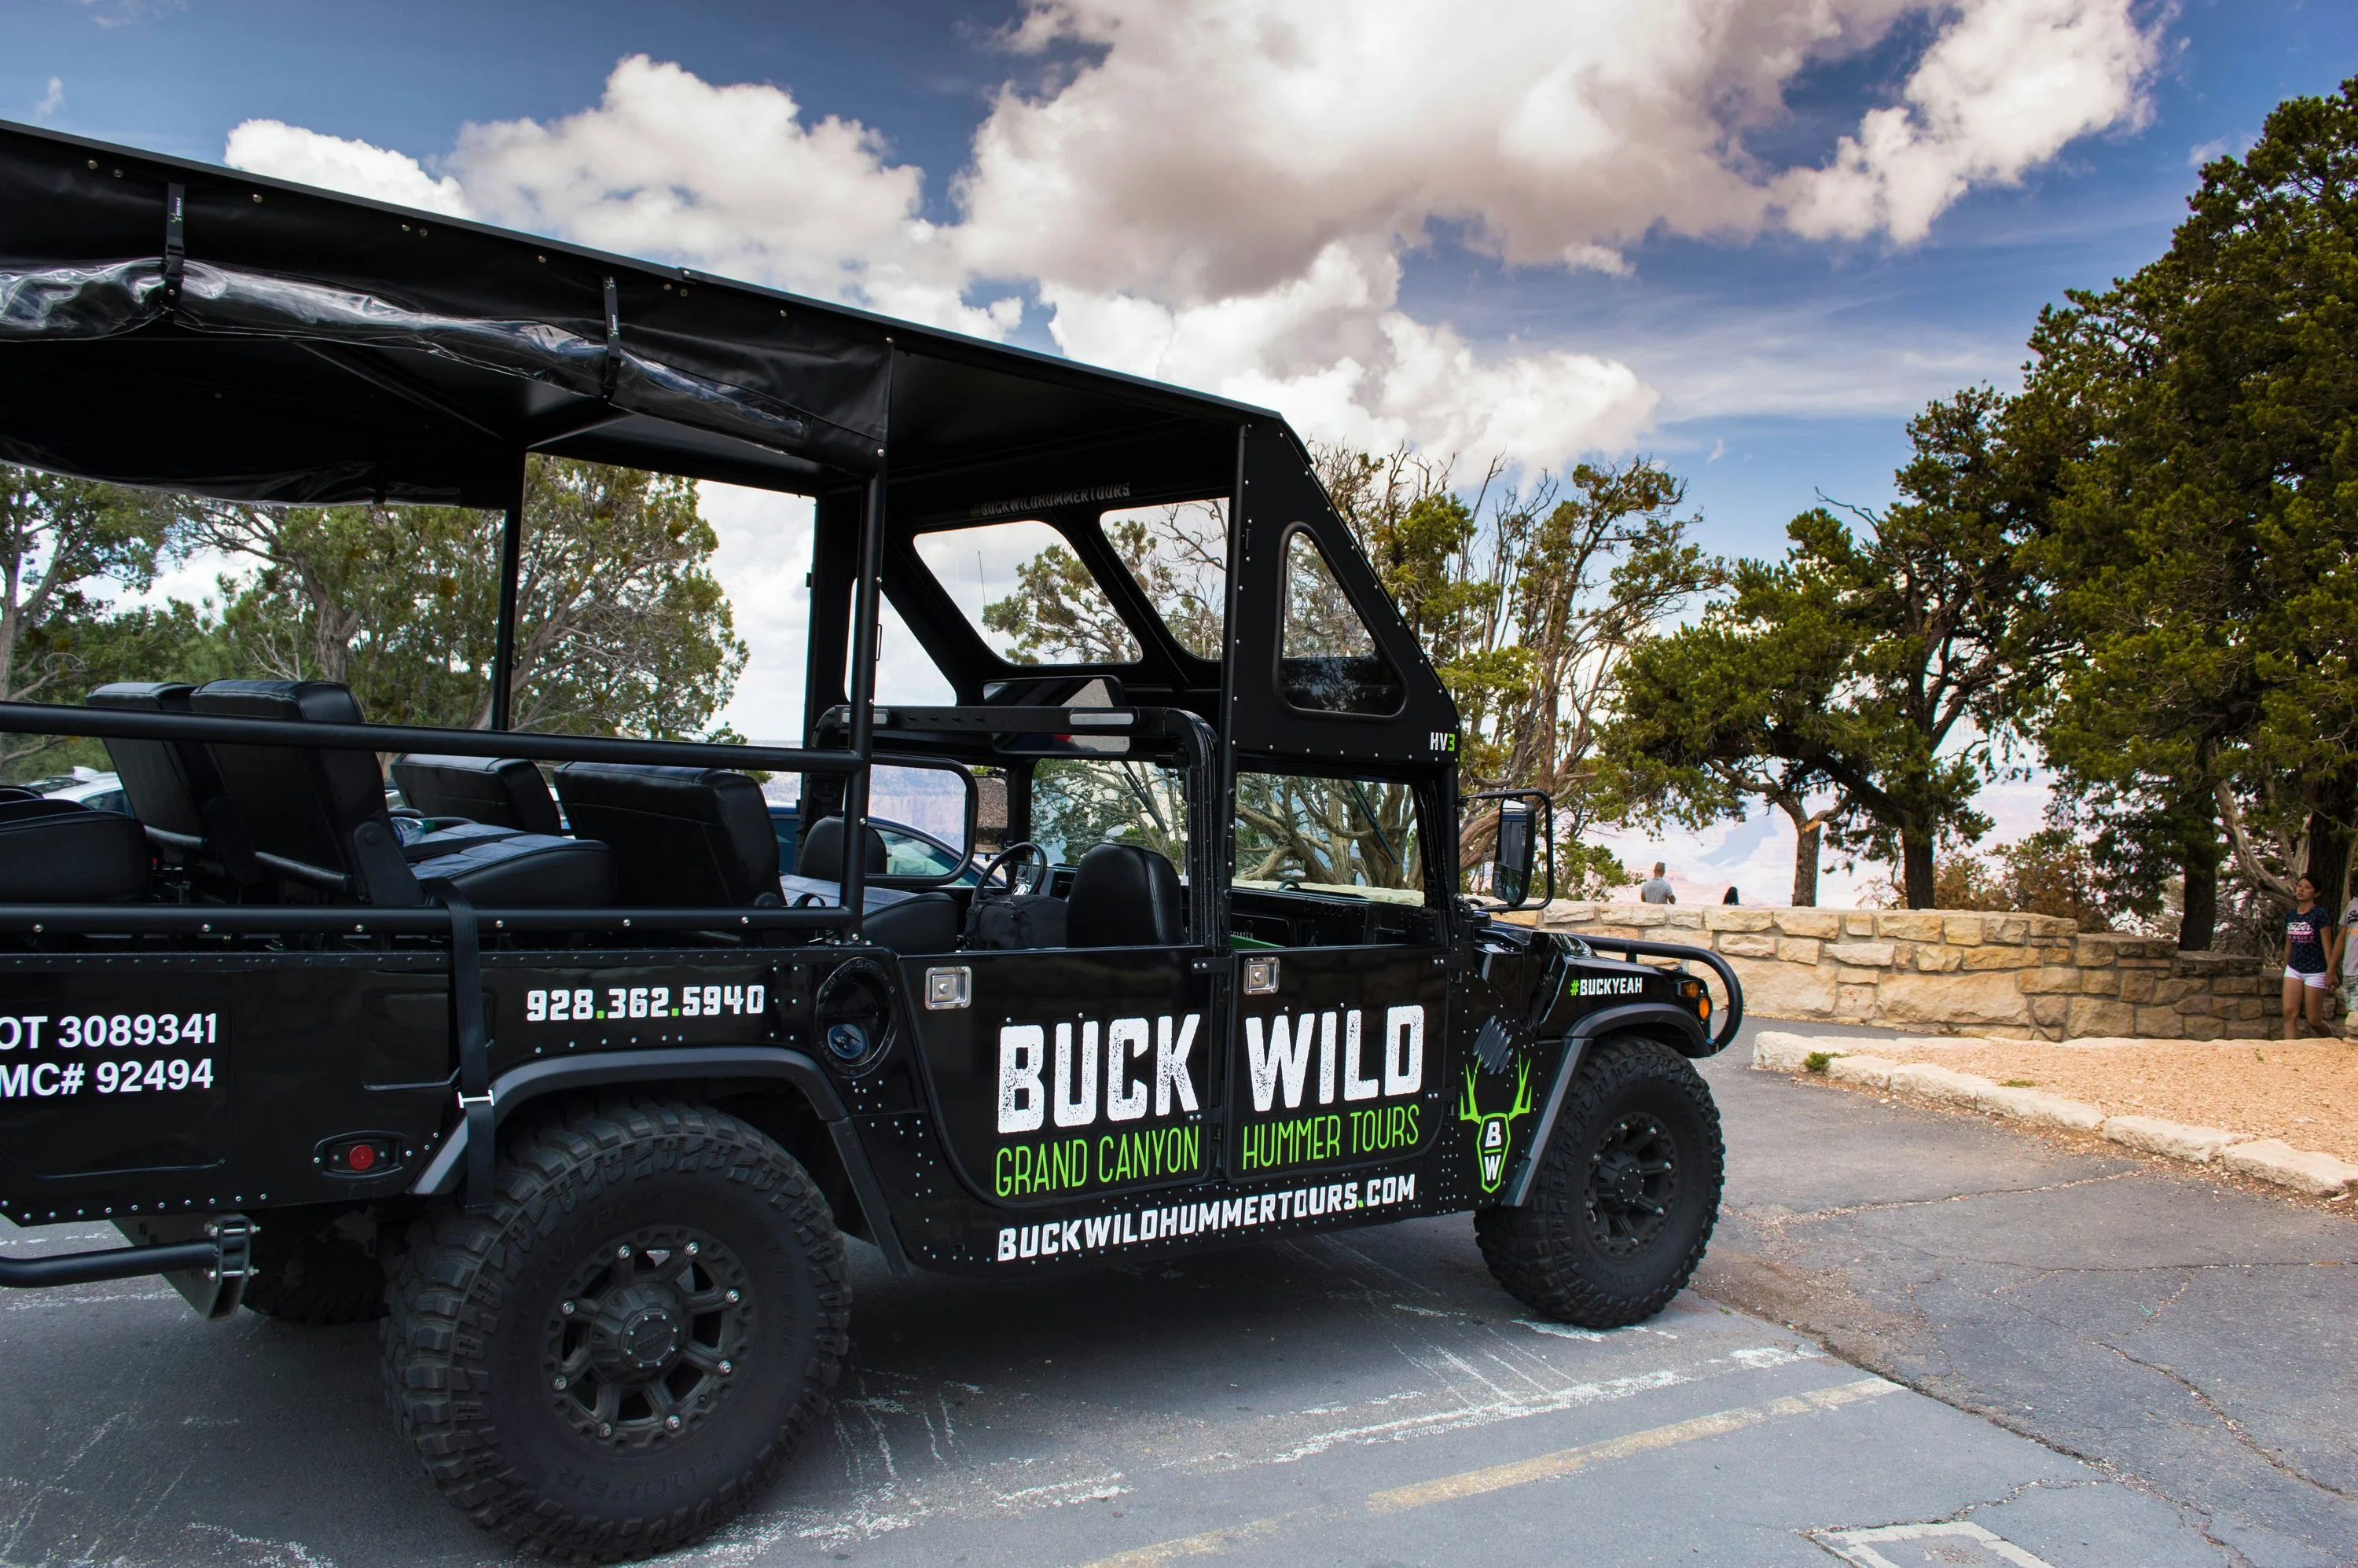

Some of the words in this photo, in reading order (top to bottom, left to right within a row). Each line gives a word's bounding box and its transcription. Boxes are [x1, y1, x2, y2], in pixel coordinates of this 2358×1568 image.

[1431, 732, 1455, 751] HV3
[527, 985, 765, 1022] 928.362.5940
[1570, 977, 1643, 996] #BUCKYEAH
[58, 1012, 217, 1048] 3089341
[0, 1063, 85, 1097] MC#
[96, 1058, 214, 1093] 92494
[997, 1013, 1201, 1134] BUCK
[1245, 1004, 1424, 1112] WILD
[995, 1139, 1088, 1197] GRAND
[1098, 1125, 1199, 1181] CANYON
[1243, 1118, 1341, 1170] HUMMER
[1350, 1105, 1420, 1153] TOURS
[1485, 1122, 1502, 1148] B
[1484, 1154, 1503, 1181] W
[996, 1173, 1416, 1262] BUCKWILDHUMMERTOURS.COM
